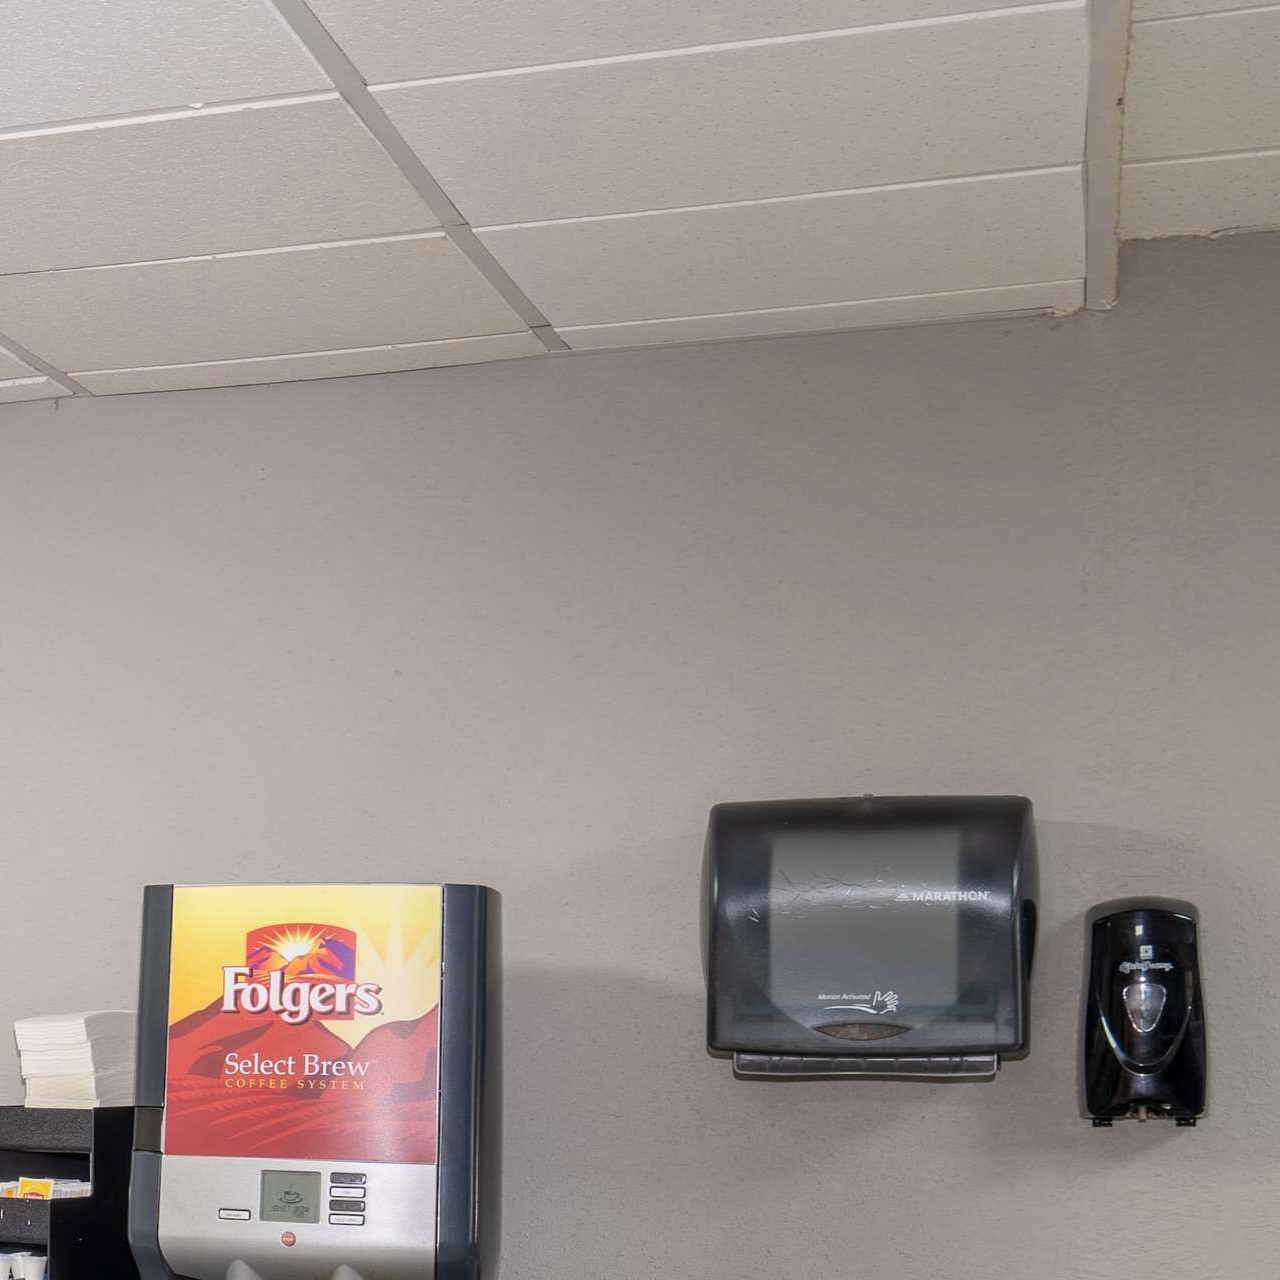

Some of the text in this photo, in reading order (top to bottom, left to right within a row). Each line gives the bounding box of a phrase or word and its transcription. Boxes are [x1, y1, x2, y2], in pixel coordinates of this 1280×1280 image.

[912, 890, 988, 902] MARATHON
[222, 966, 383, 1025] Folgers
[817, 993, 871, 1001] Motion Activated
[224, 1052, 370, 1077] Select Brew
[225, 1078, 364, 1090] COFFEE SYSTEM
